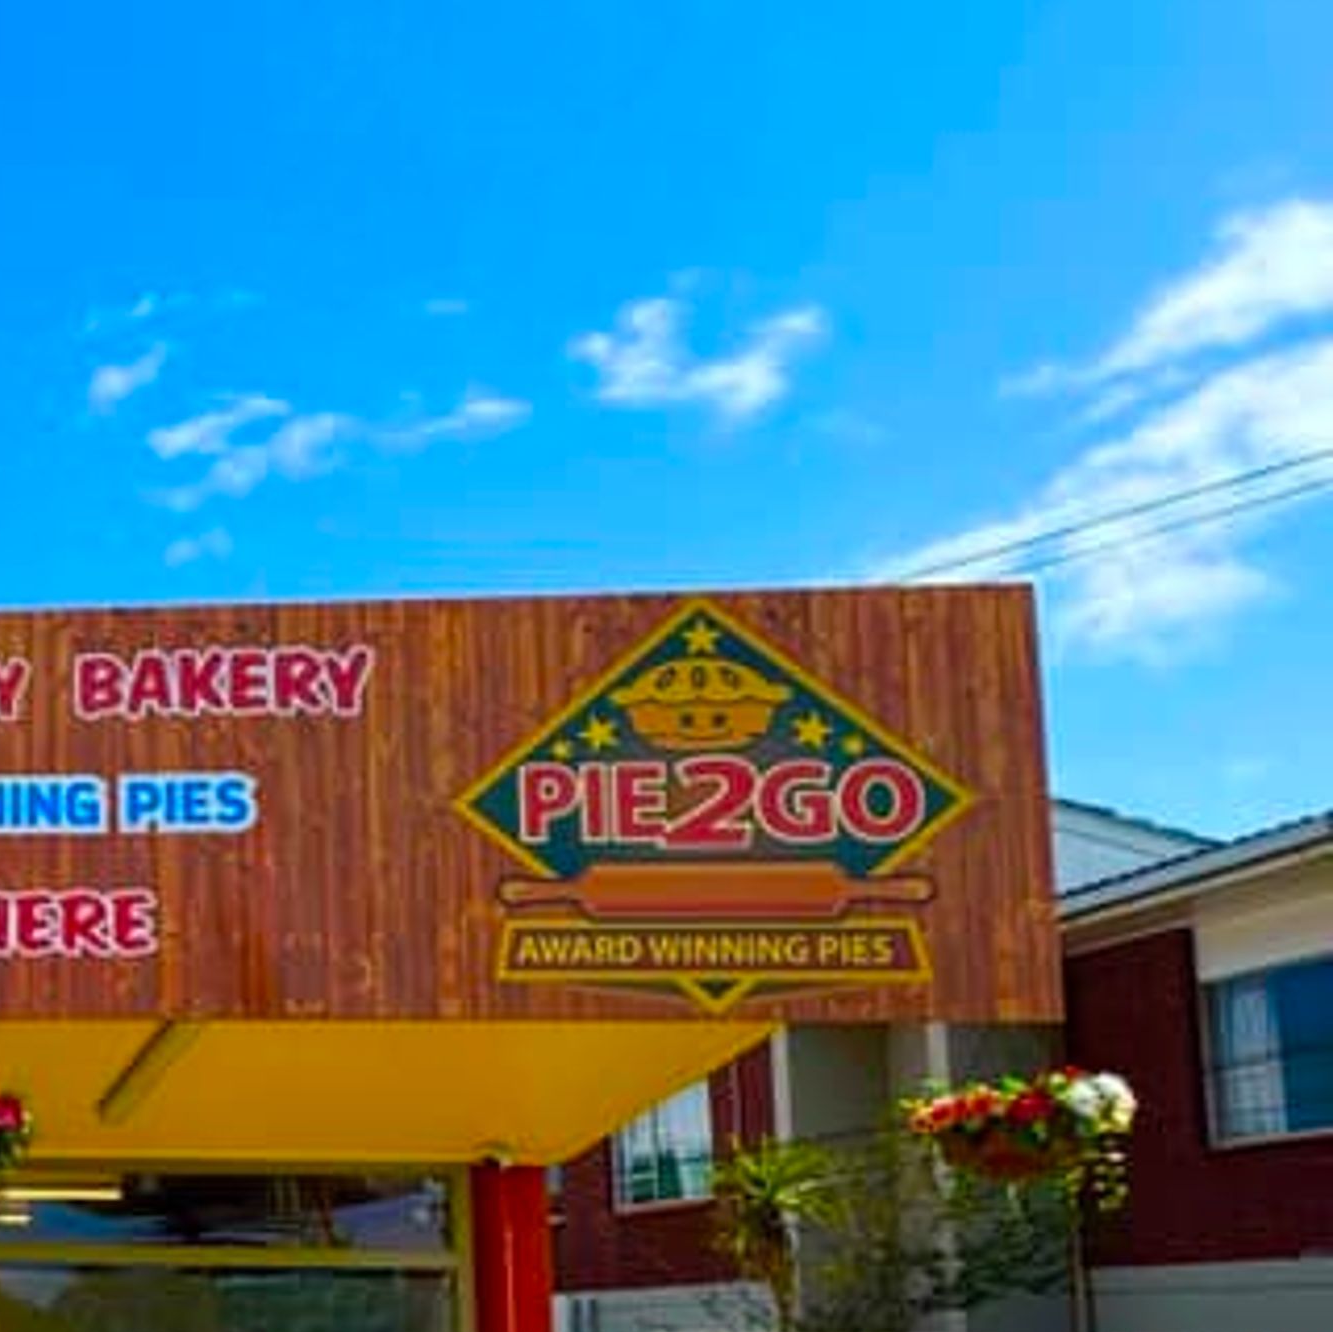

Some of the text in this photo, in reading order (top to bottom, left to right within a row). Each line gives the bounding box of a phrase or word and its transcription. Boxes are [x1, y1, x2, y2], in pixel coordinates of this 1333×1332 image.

[72, 646, 375, 720] BAKERY
[119, 773, 258, 834] PIES
[516, 754, 927, 849] PIE2GO
[517, 934, 894, 966] AWARD WINNING PIES
